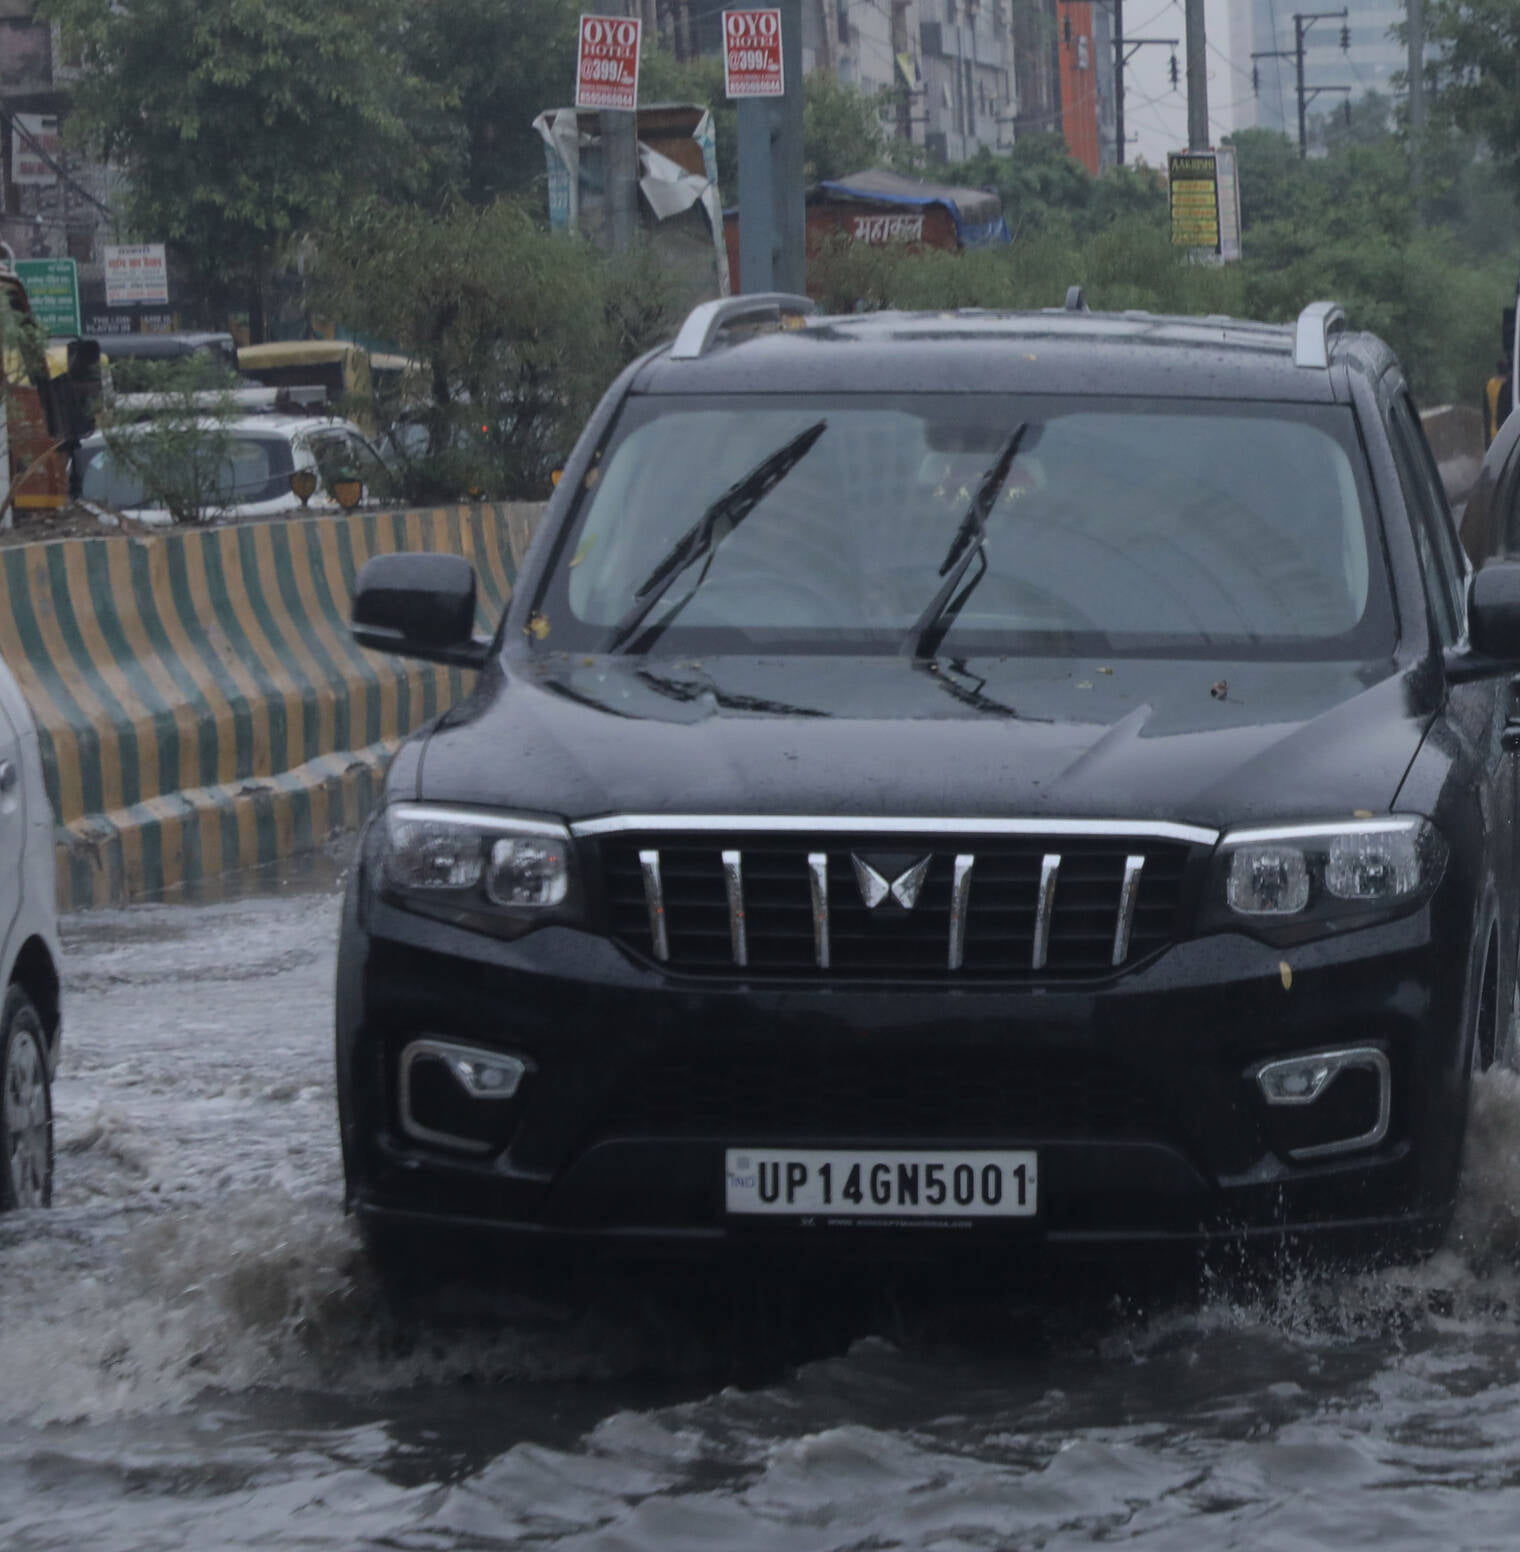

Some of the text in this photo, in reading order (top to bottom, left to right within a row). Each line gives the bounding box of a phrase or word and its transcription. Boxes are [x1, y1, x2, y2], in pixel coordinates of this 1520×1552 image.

[584, 20, 636, 46] OYO
[728, 14, 777, 36] OYO
[584, 44, 634, 58] HOTEL
[729, 36, 778, 48] HOTEL
[757, 1161, 1026, 1207] UP14GN5001
